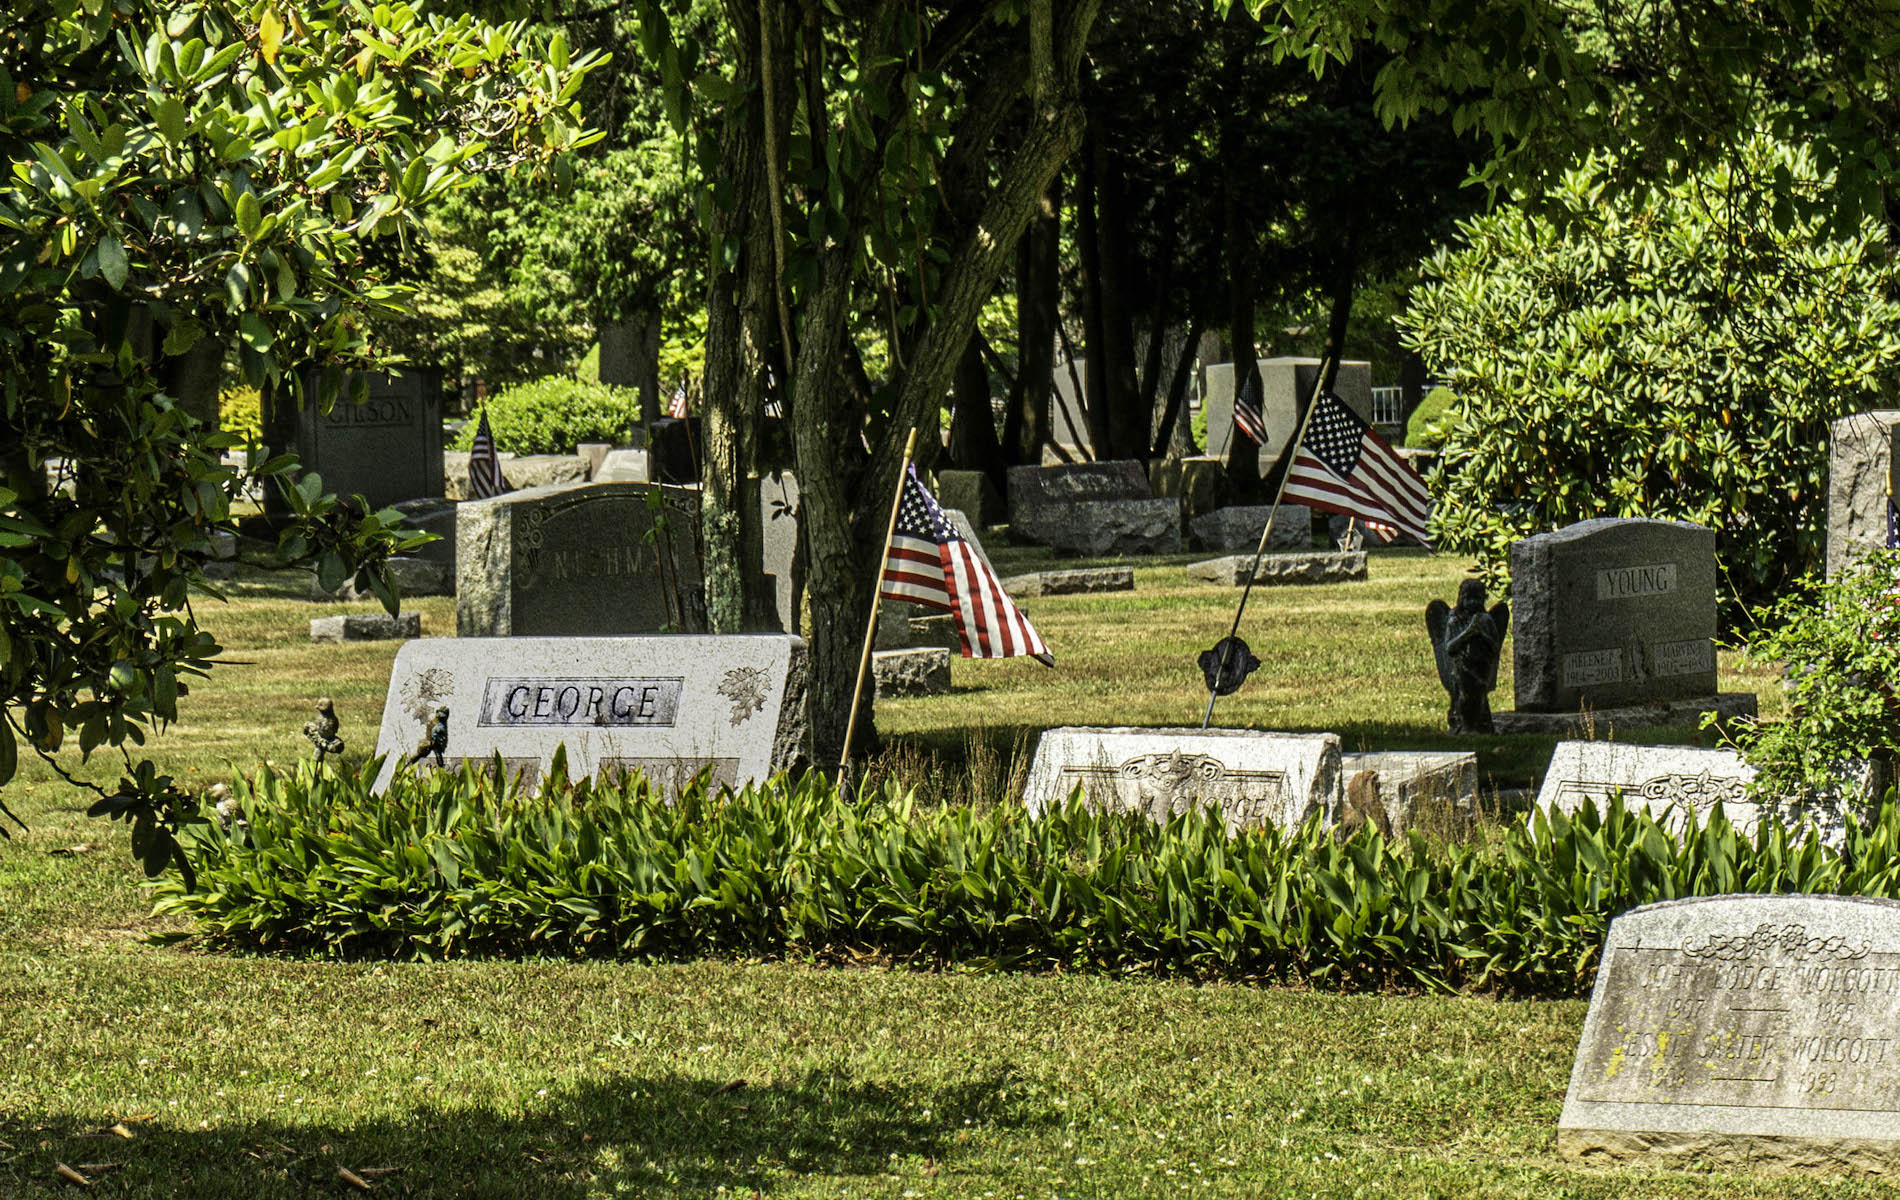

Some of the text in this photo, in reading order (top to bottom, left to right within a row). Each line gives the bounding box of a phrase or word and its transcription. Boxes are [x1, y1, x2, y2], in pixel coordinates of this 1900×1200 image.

[1607, 568, 1668, 595] YOUNG
[507, 685, 659, 718] GEORGE
[1171, 795, 1266, 819] GORGE
[1713, 964, 1785, 992] LODGE
[1798, 966, 1900, 994] WOLCOTT
[1793, 1036, 1893, 1064] WOLCOTT
